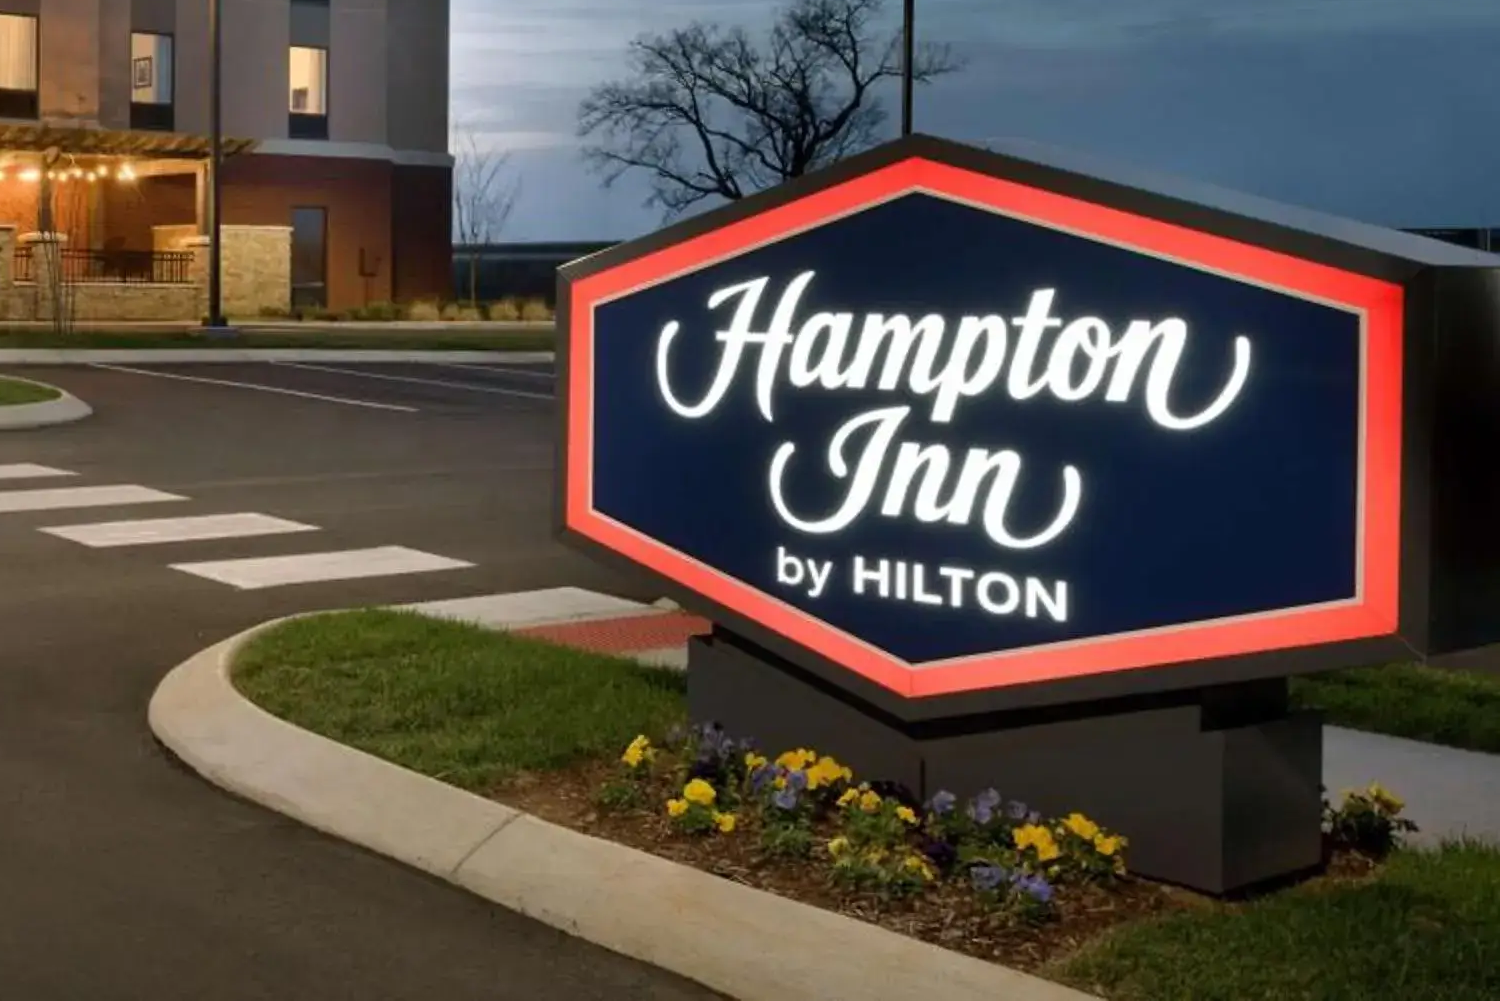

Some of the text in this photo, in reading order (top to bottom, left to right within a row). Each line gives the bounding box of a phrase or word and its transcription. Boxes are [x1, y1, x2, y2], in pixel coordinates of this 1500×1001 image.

[656, 270, 1251, 430] Hampton
[769, 405, 1082, 549] Inn
[777, 546, 1067, 622] by HILTON
